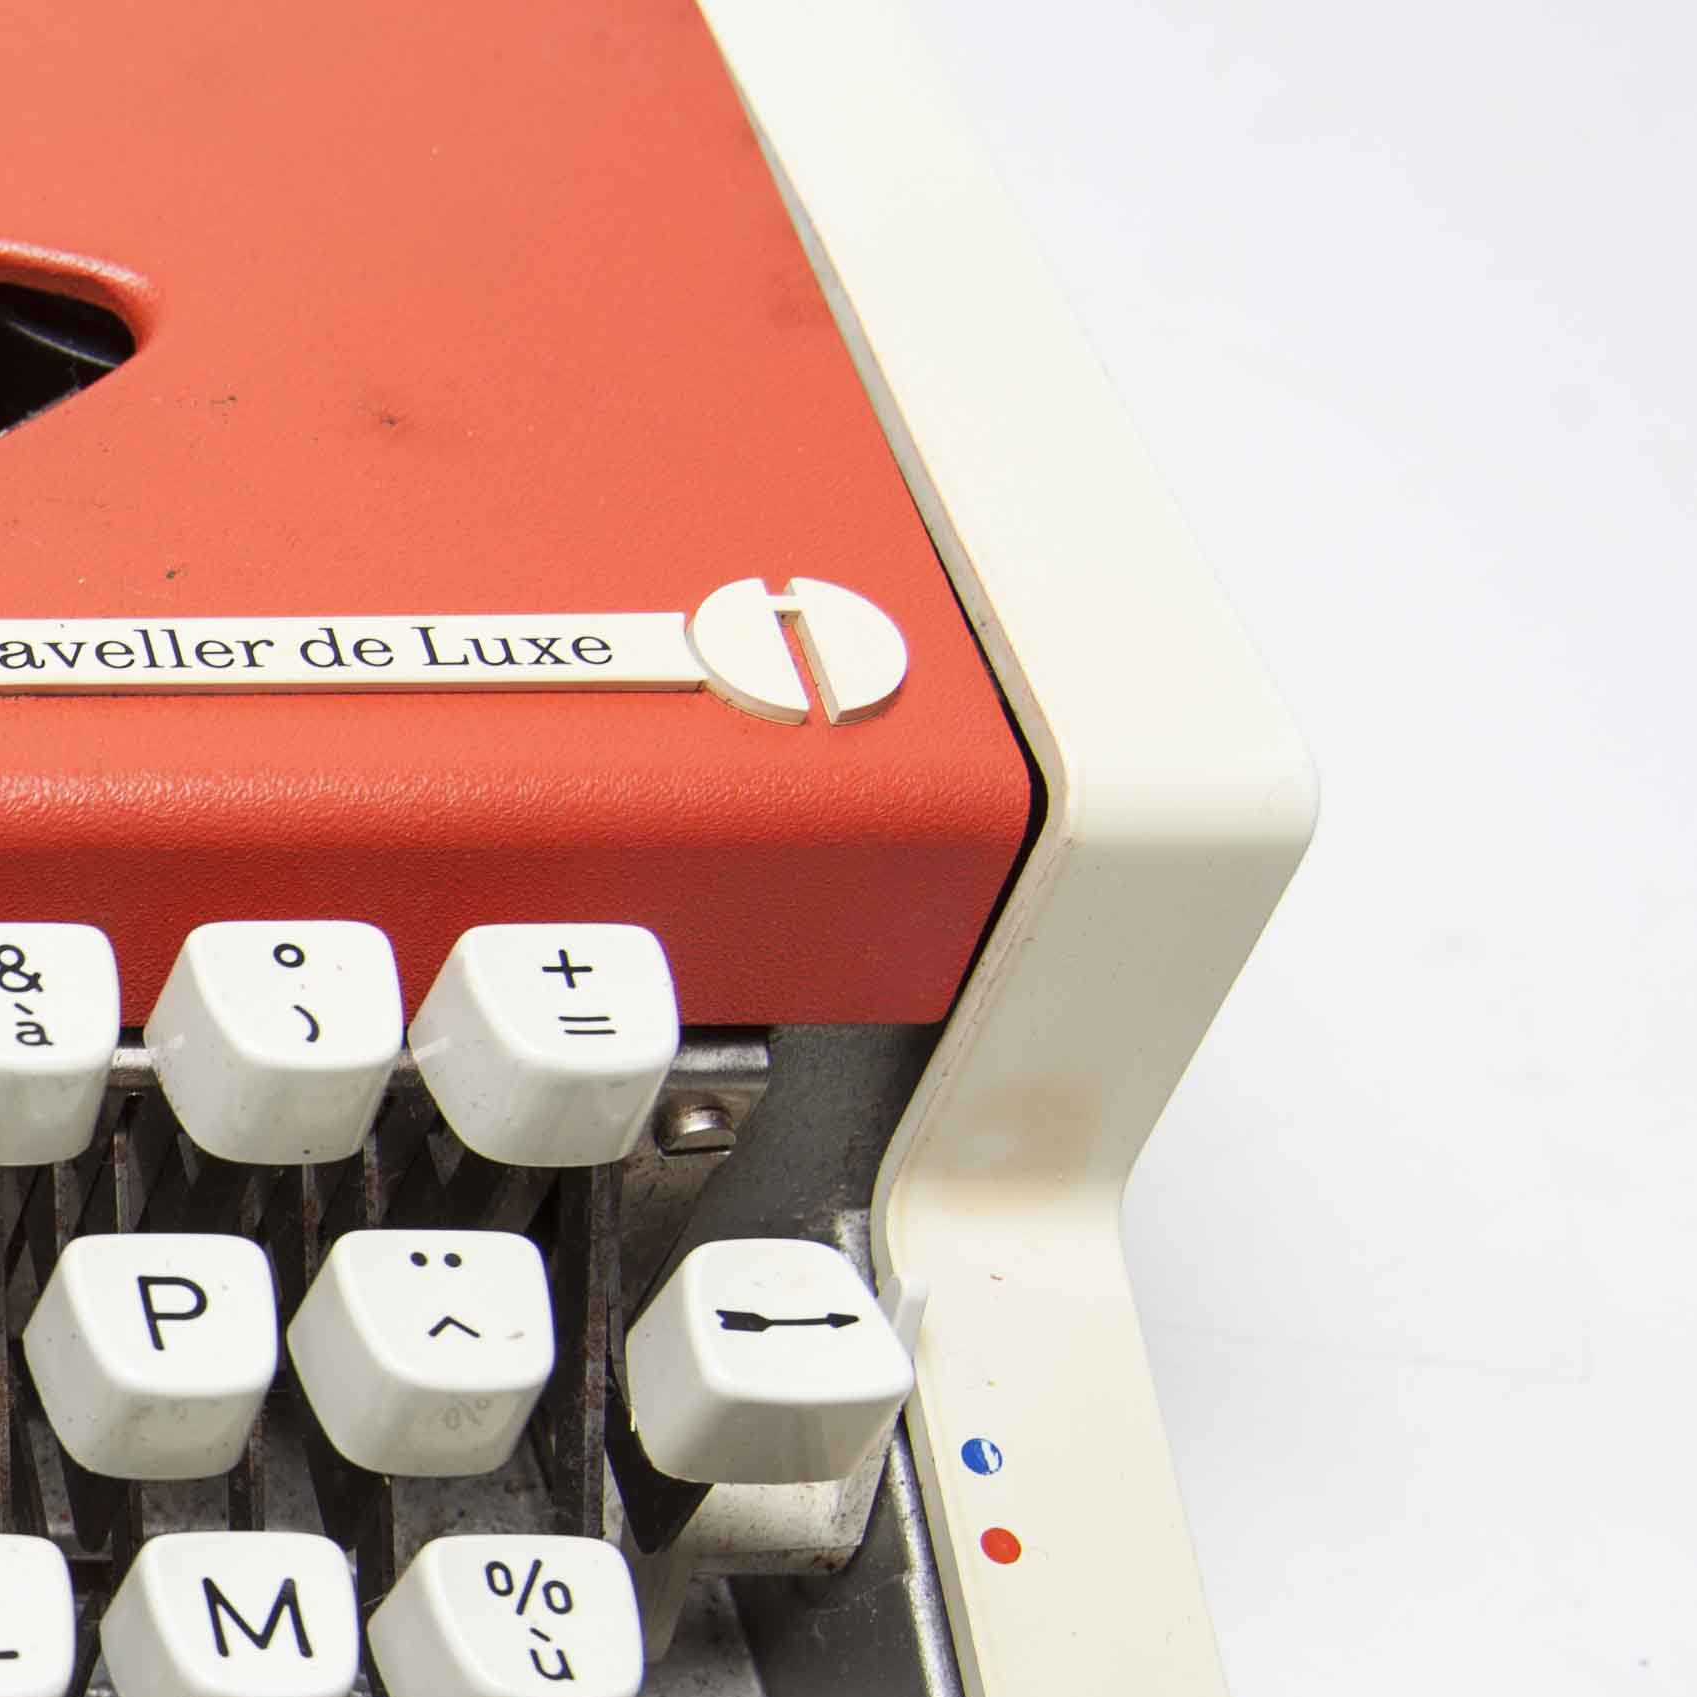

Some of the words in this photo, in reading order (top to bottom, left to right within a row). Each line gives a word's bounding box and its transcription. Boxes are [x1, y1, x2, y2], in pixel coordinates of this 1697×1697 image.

[298, 626, 395, 669] de
[412, 625, 614, 668] Luxe
[13, 1001, 55, 1048] à
[136, 1274, 209, 1352] P
[484, 1558, 574, 1617] %
[201, 1576, 314, 1660] M
[529, 1626, 576, 1682] ù
